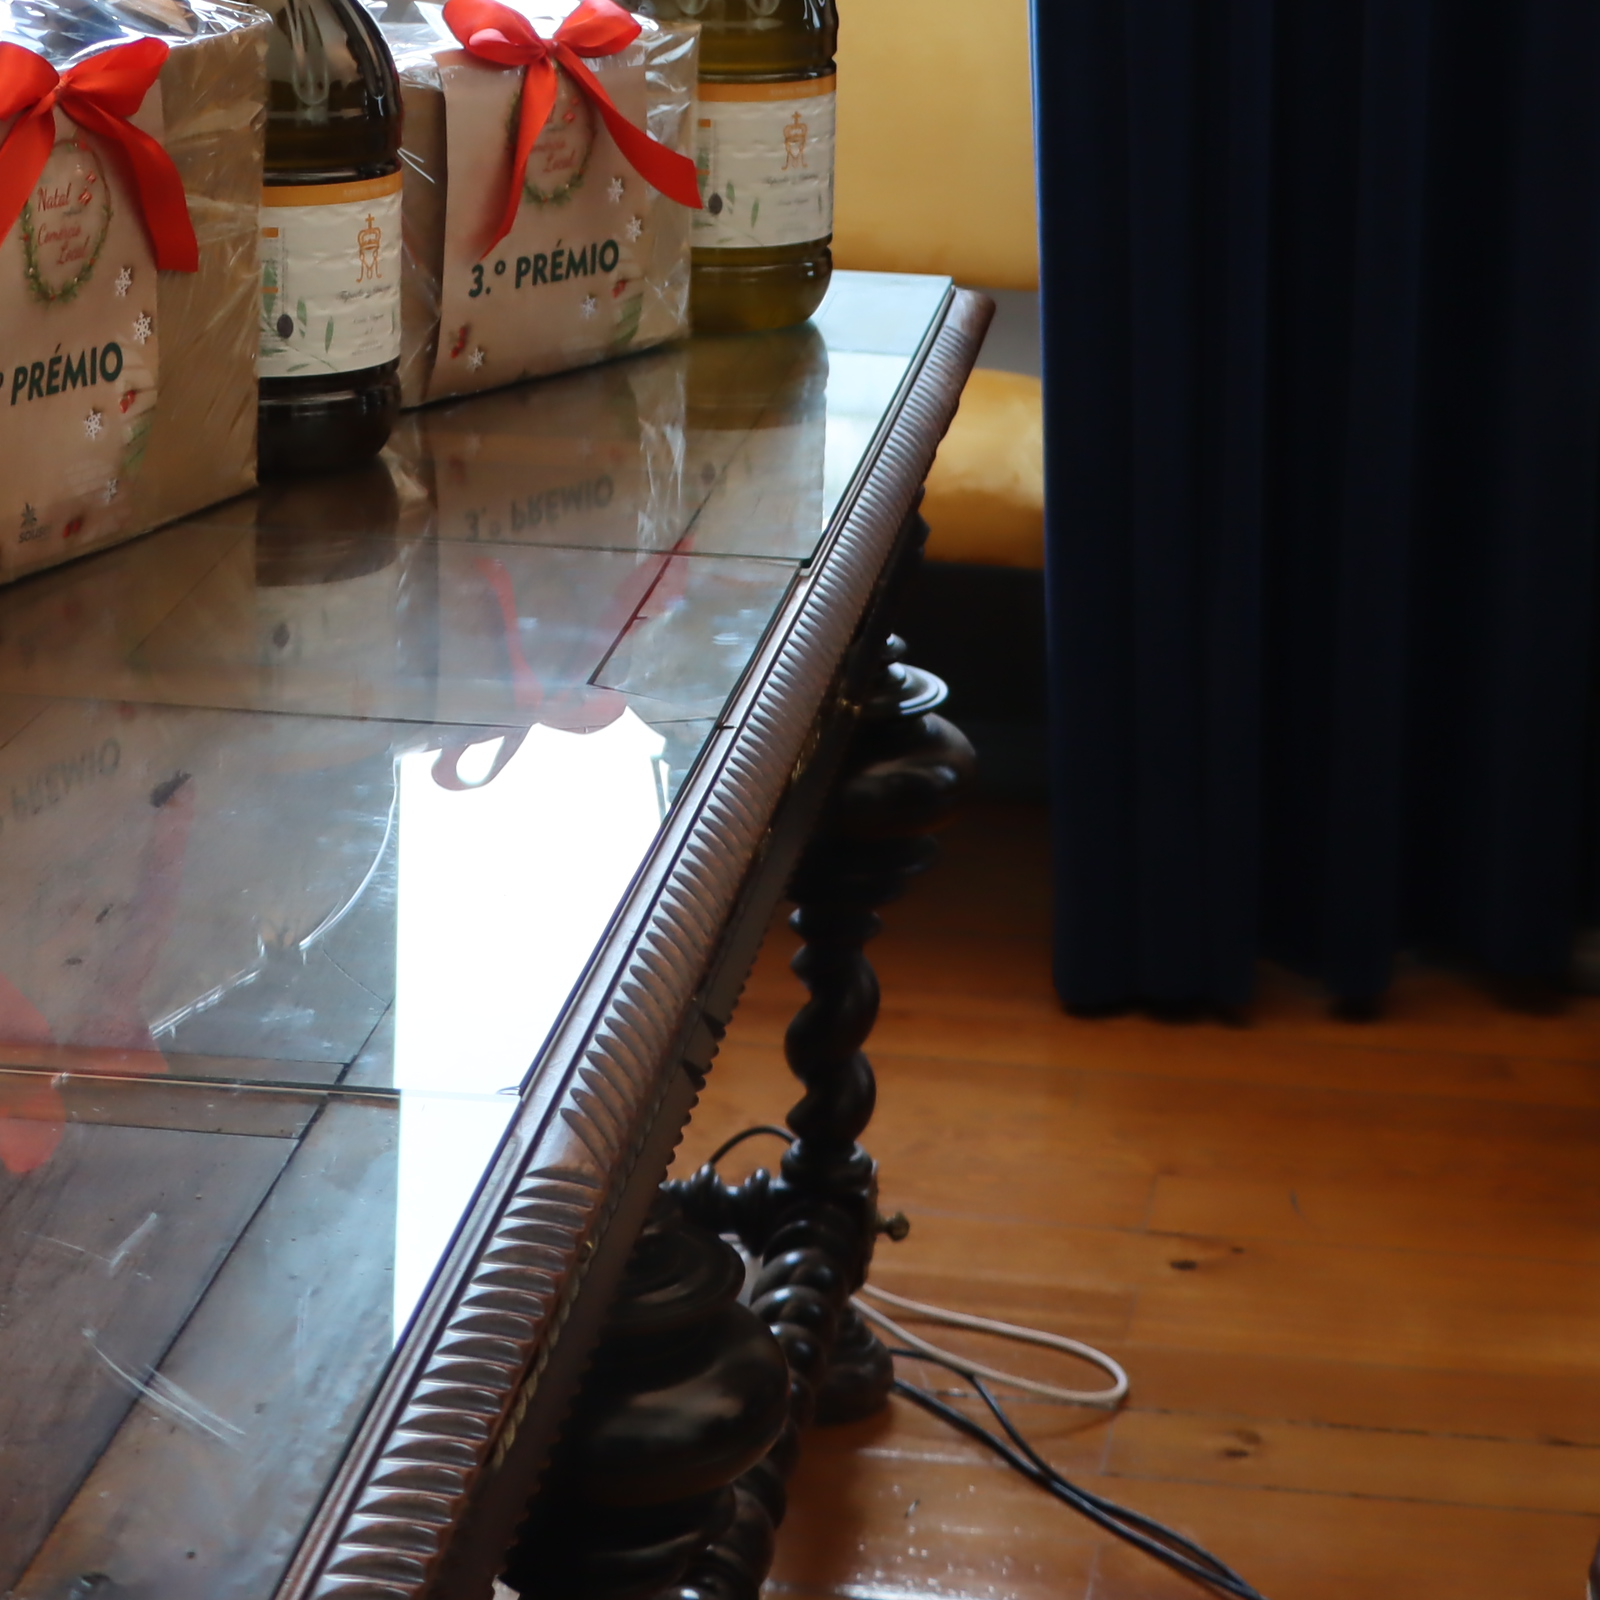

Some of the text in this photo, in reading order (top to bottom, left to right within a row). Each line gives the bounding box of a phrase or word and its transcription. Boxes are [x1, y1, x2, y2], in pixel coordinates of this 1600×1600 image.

[37, 182, 72, 212] Natal
[515, 238, 621, 290] PRÉMIO
[11, 342, 124, 406] PRÉMIO
